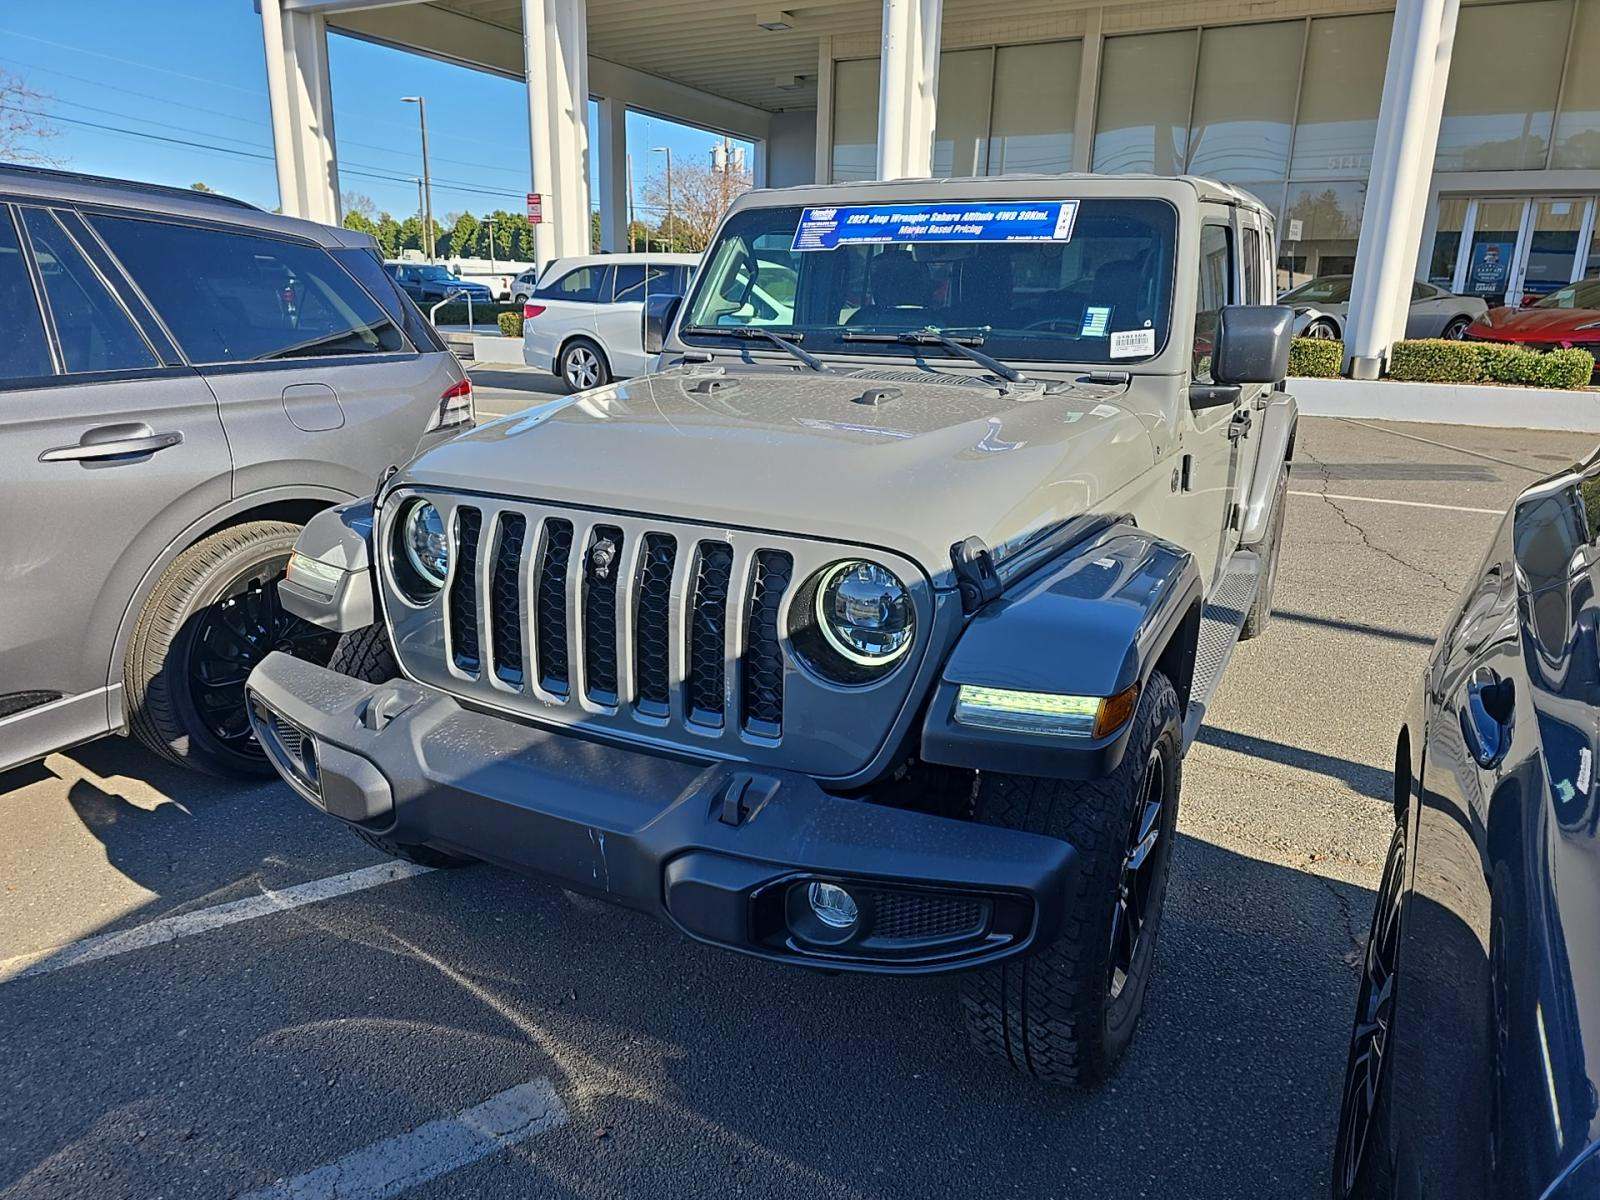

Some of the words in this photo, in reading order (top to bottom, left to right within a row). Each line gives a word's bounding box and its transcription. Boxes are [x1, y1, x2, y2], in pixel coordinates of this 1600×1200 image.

[869, 214, 890, 225] Jeep
[890, 212, 930, 224] Wrangler
[930, 211, 962, 221] Sahara
[960, 211, 995, 221] Altitude
[995, 211, 1018, 221] 4WD
[898, 225, 928, 235] Market
[927, 224, 954, 234] Based
[953, 223, 983, 235] Pricing
